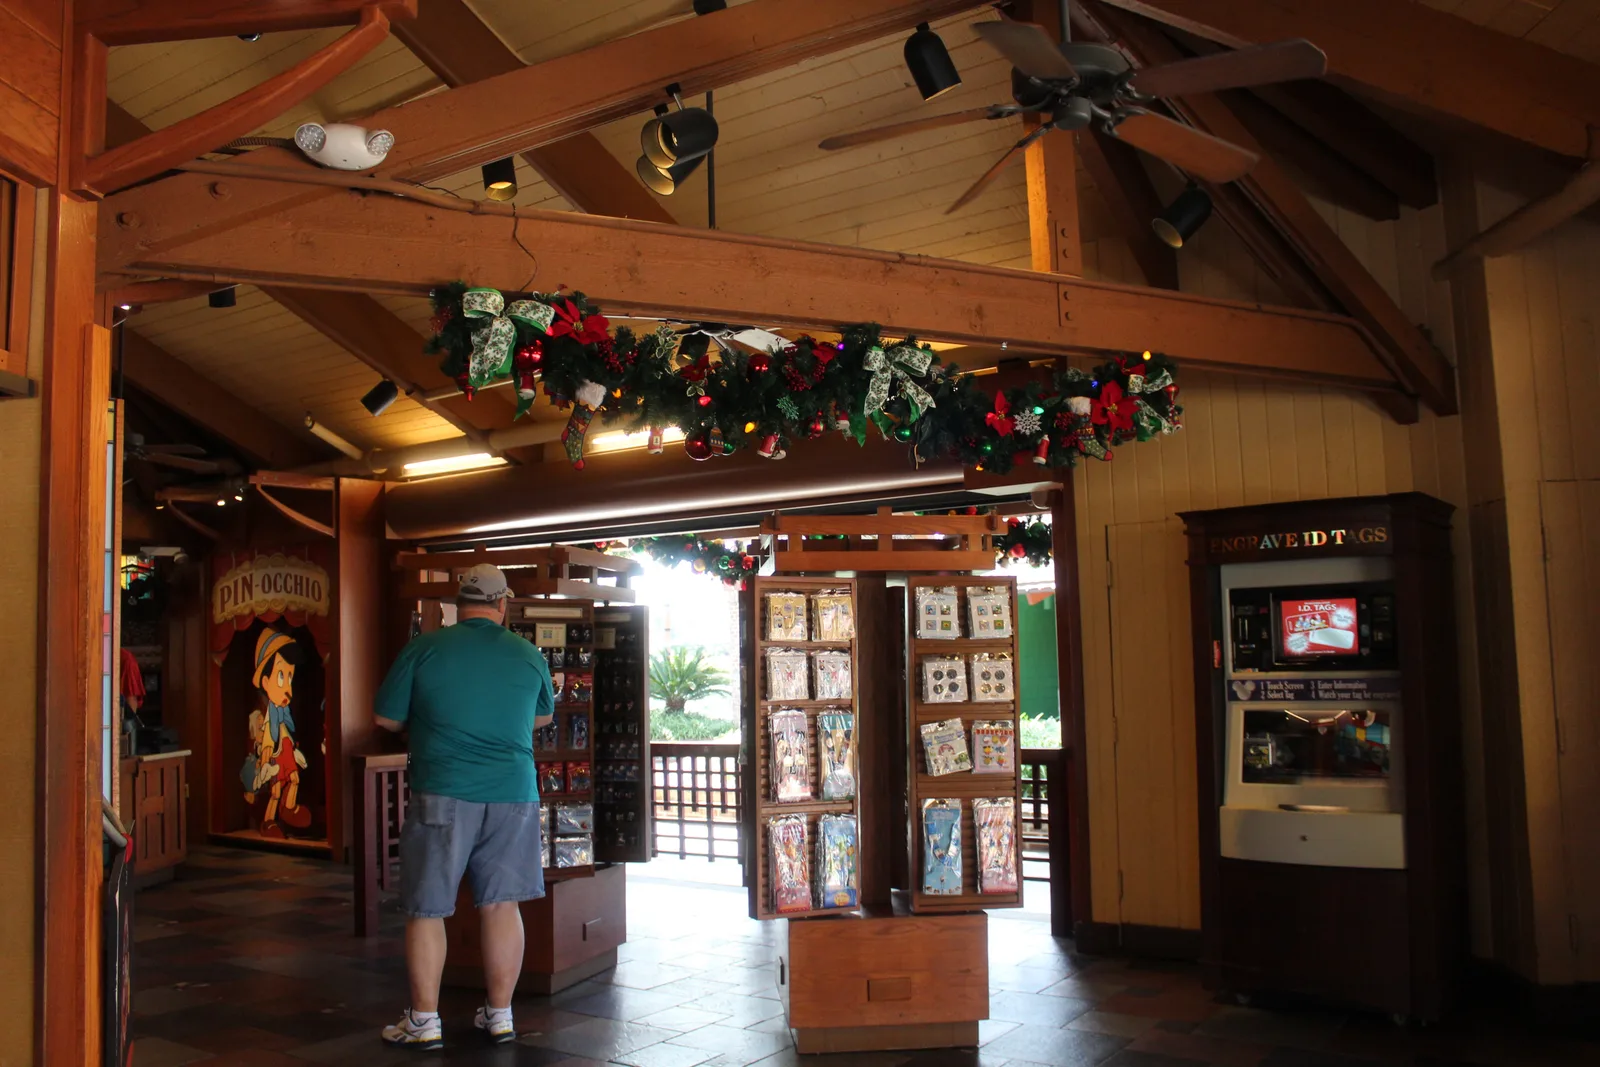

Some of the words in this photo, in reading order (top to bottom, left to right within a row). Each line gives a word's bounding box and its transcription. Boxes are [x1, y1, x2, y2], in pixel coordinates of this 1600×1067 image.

[1211, 533, 1298, 553] ENGRAVE
[1303, 530, 1327, 547] ID
[1331, 527, 1388, 545] TAGS
[219, 572, 323, 614] PIN-OCCHIO
[1266, 681, 1283, 690] Touch
[1284, 681, 1305, 690] Screen
[1317, 680, 1333, 689] Enter
[1334, 680, 1368, 689] Information
[1267, 690, 1283, 699] Select
[1284, 690, 1295, 700] Tag
[1317, 690, 1337, 699] Watch
[1337, 692, 1352, 700] your
[1352, 690, 1364, 700] tag
